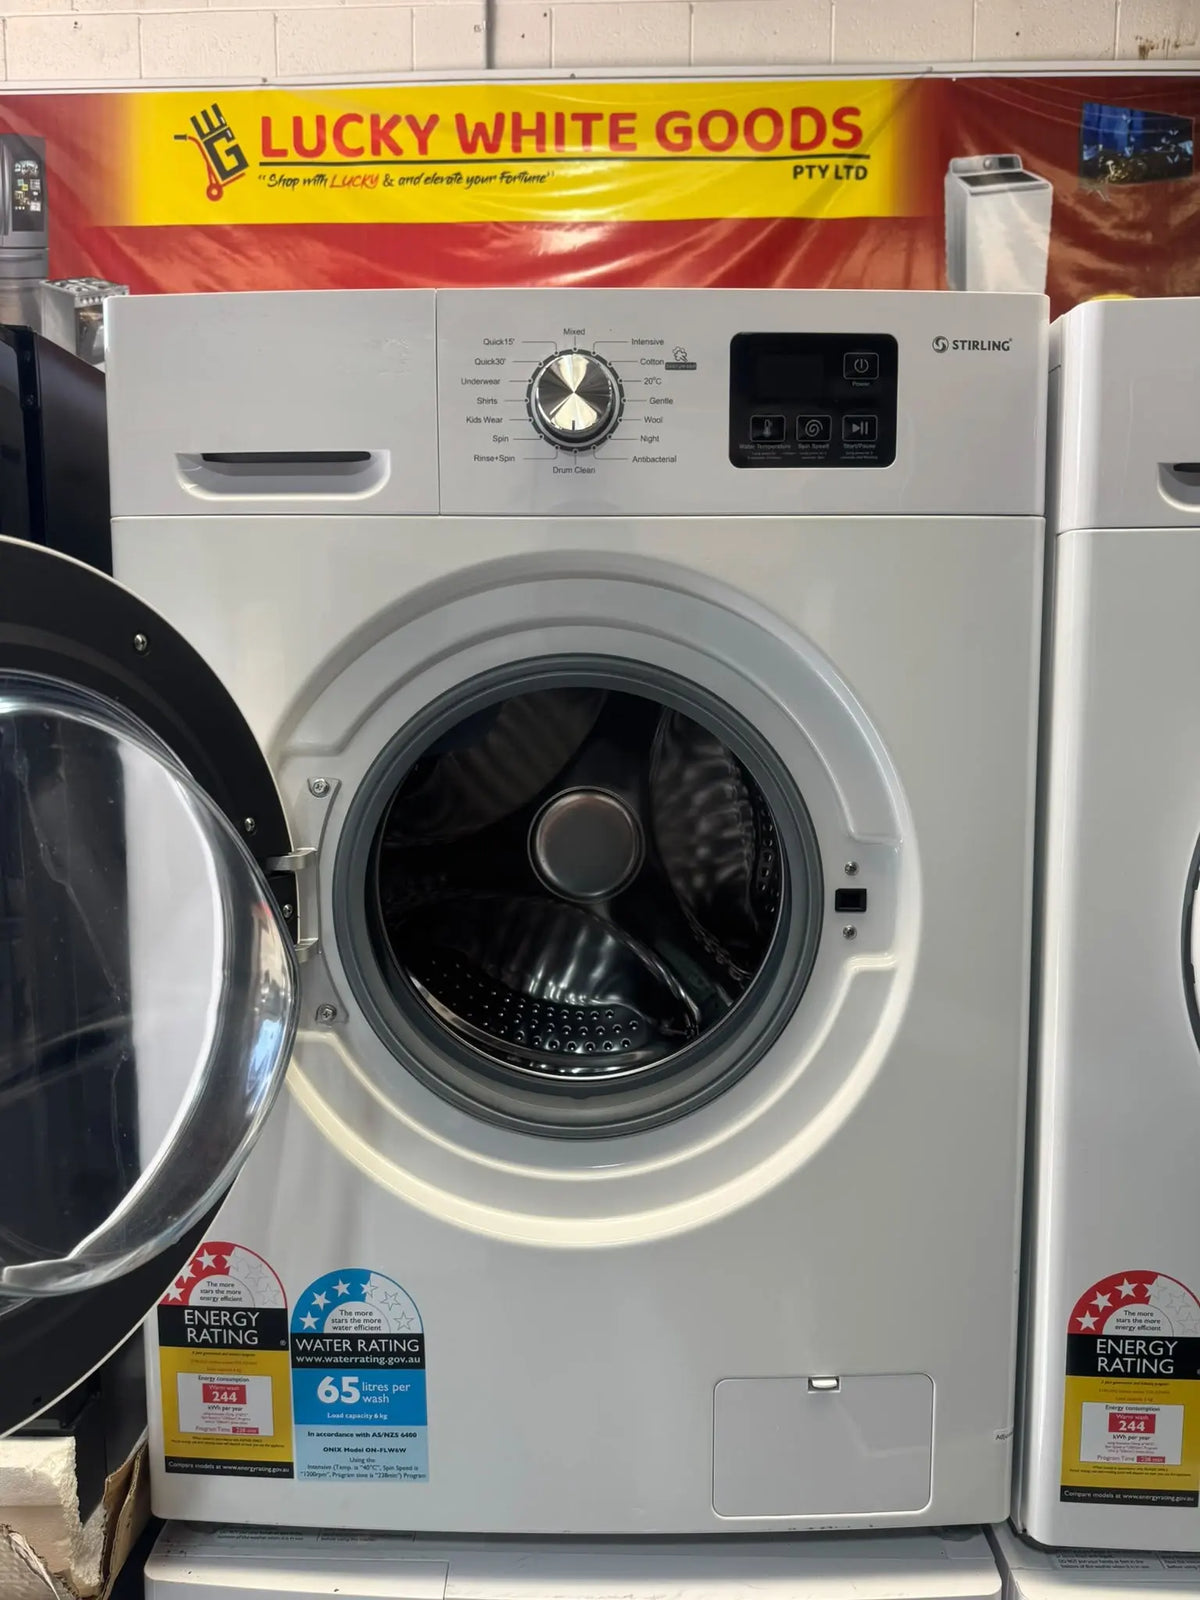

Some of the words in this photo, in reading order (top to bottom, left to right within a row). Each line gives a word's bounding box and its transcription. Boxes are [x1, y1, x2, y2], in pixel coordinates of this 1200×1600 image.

[261, 112, 440, 158] LUCKY
[454, 111, 637, 155] WHITE
[655, 106, 863, 153] GOODS
[793, 164, 829, 180] PTY
[834, 165, 868, 181] LTD
[302, 174, 328, 187] with
[329, 174, 378, 189] LUCKY
[383, 174, 395, 187] &
[398, 173, 420, 186] and
[423, 172, 464, 186] elevate
[465, 174, 497, 190] your
[563, 328, 586, 336] Mixed
[631, 338, 664, 346] Intensive
[952, 339, 1010, 351] STIRLING
[639, 358, 665, 366] Cotton
[461, 377, 500, 385] Underwear
[476, 397, 498, 405] Shirts
[649, 397, 674, 405] Gentle
[466, 416, 482, 424] Kids
[483, 416, 503, 424] Wear
[643, 416, 663, 424] Wool
[492, 435, 509, 443] Spin
[640, 435, 660, 444] Night
[473, 455, 516, 463] Rinse+Spin
[632, 455, 677, 463] Antibacterial
[552, 466, 573, 474] Drum
[574, 466, 596, 474] Clean
[184, 1309, 260, 1327] ENERGY
[350, 1316, 362, 1324] the
[187, 1327, 259, 1345] RATING
[295, 1338, 352, 1352] WATER
[357, 1338, 420, 1353] RATING
[1096, 1338, 1178, 1356] ENERGY
[295, 1355, 421, 1365] www.waterrating.gov.au
[1097, 1356, 1174, 1374] RATING
[317, 1375, 361, 1404] 65
[362, 1381, 389, 1392] litres
[392, 1383, 411, 1394] per
[212, 1391, 238, 1402] 244
[362, 1393, 390, 1404] wash
[345, 1412, 373, 1420] capacity
[379, 1412, 388, 1420] kg
[1119, 1420, 1145, 1432] 244
[168, 1461, 194, 1469] Compare
[195, 1462, 215, 1470] models
[1063, 1490, 1091, 1498] Compare
